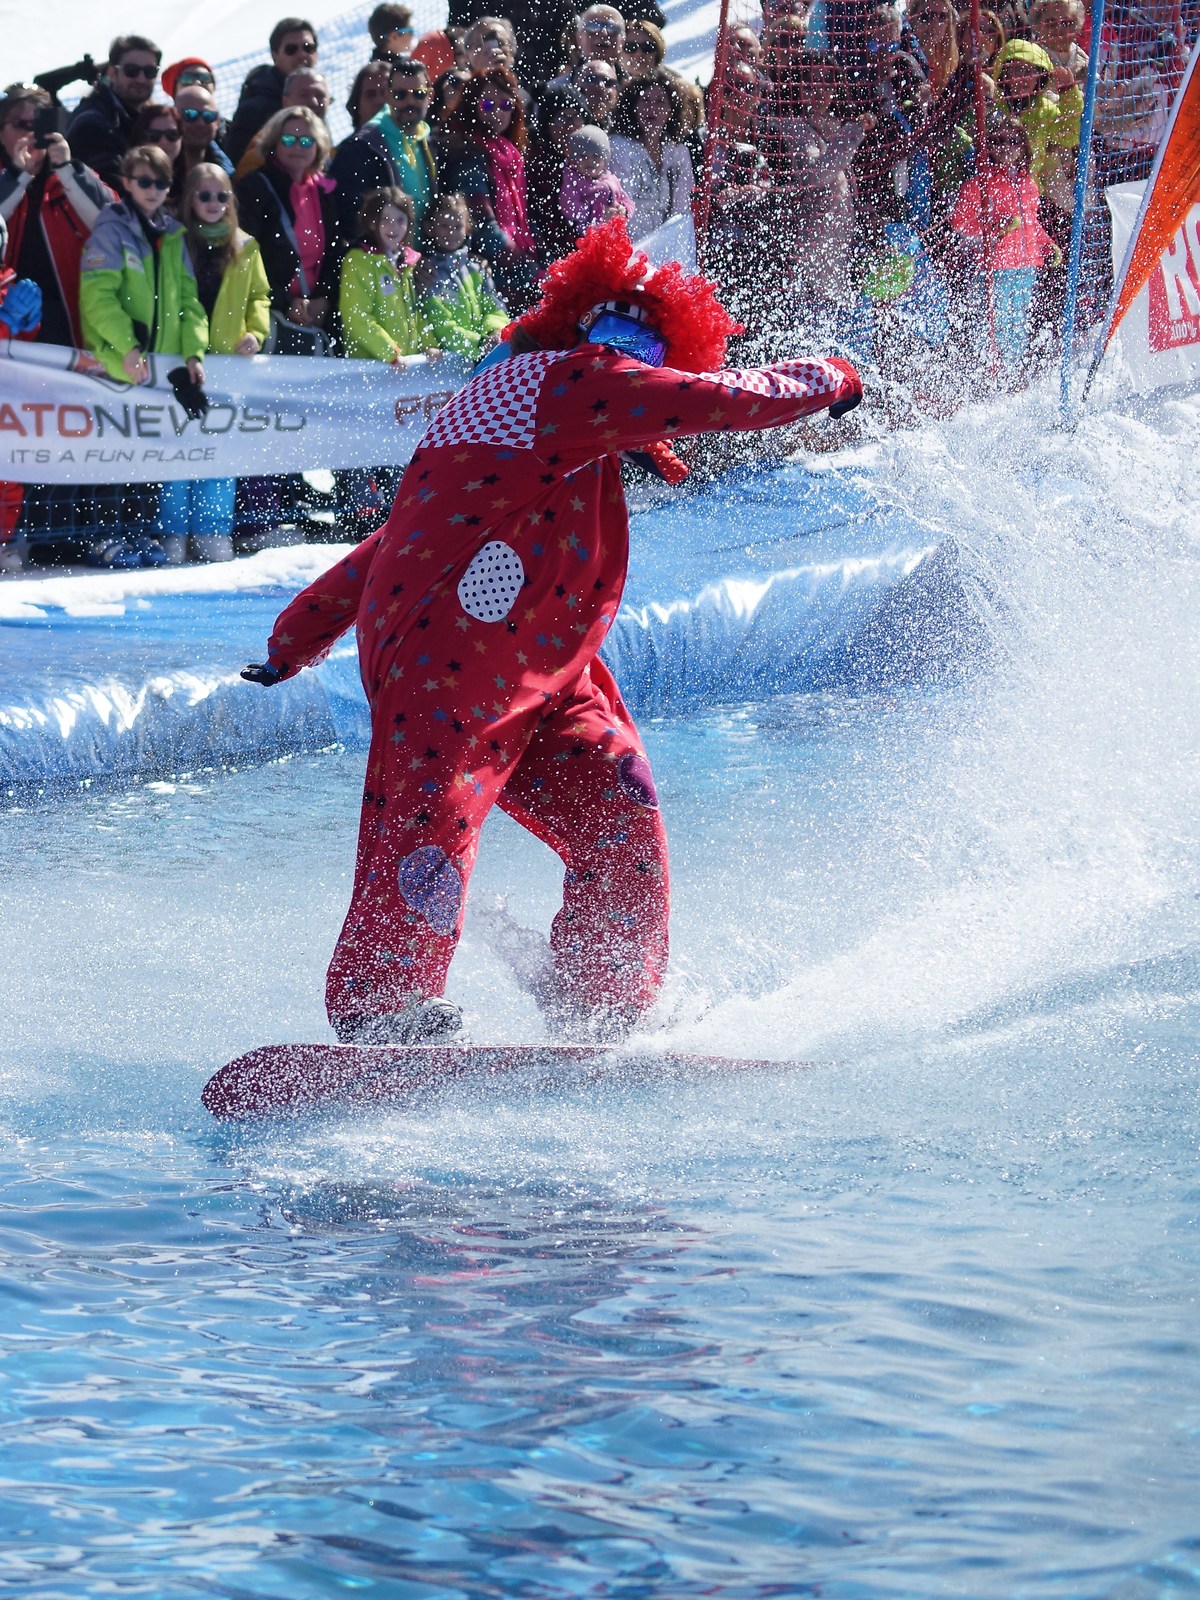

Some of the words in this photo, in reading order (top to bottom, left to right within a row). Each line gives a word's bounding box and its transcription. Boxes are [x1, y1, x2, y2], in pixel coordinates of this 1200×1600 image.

[11, 449, 51, 464] IT'S
[59, 449, 76, 463] A
[85, 449, 135, 463] FUN
[142, 446, 218, 463] PLACE
